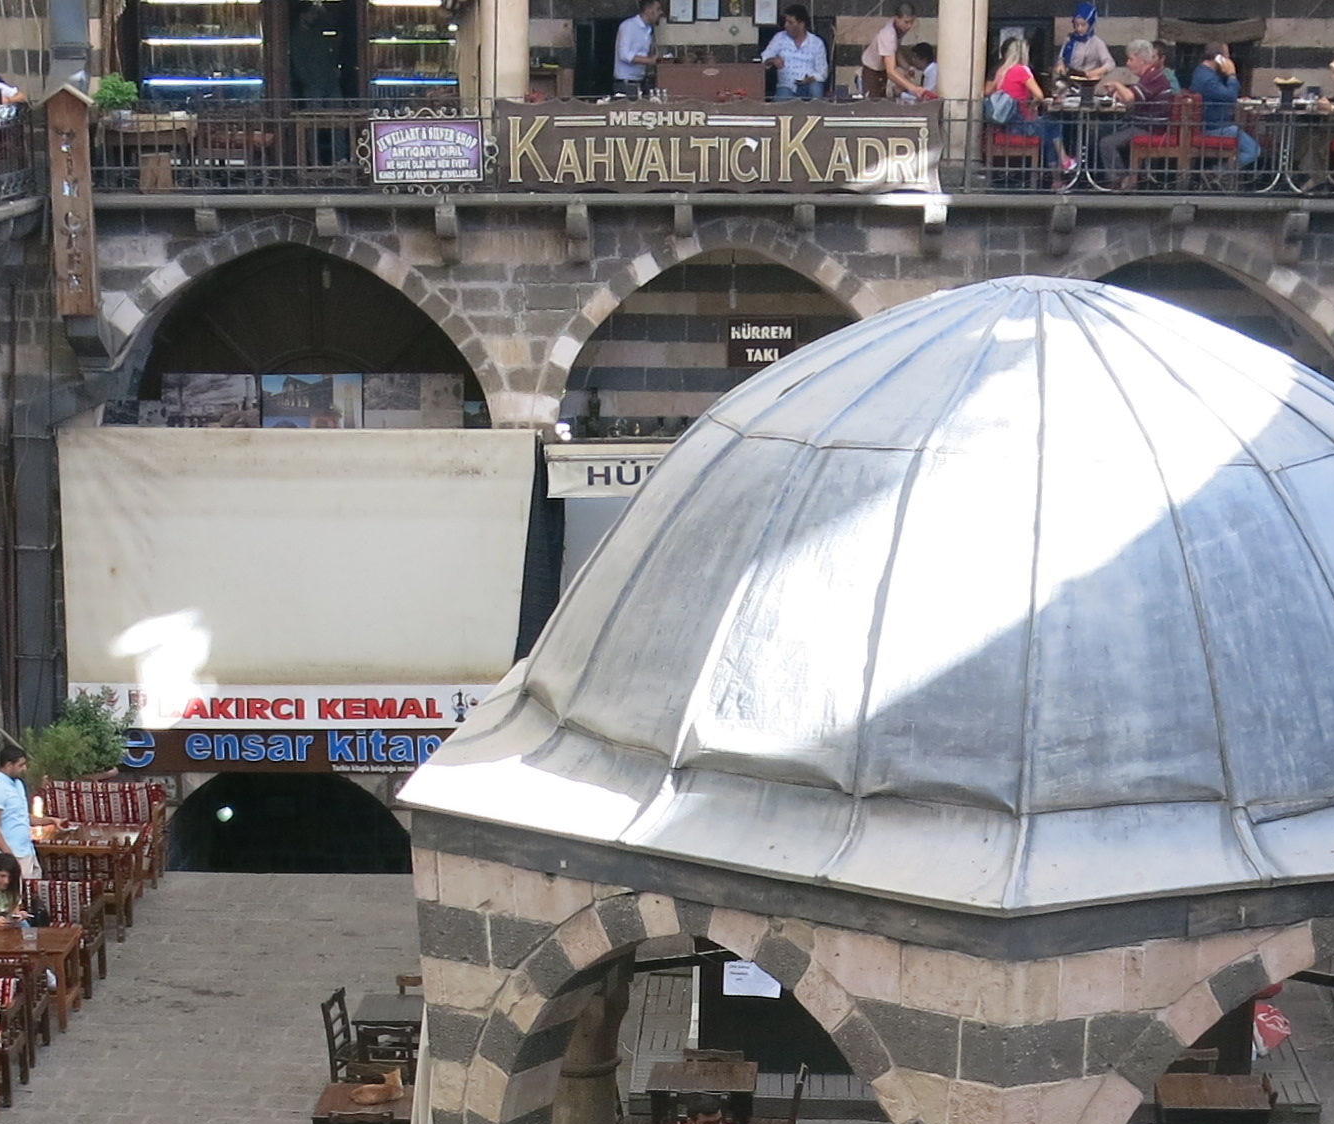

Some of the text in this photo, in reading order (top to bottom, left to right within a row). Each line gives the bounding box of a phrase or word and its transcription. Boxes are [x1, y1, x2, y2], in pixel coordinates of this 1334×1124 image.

[609, 111, 706, 130] MEŞHUR
[456, 131, 478, 149] SHOP
[508, 115, 930, 184] KAHVALTICI KADRİ
[731, 322, 792, 339] HÜRREM
[746, 348, 779, 362] TAKI
[587, 461, 654, 485] HÜ
[160, 698, 442, 719] AKIRCI KEMAL
[185, 731, 315, 762] ensar
[327, 730, 442, 767] kitap
